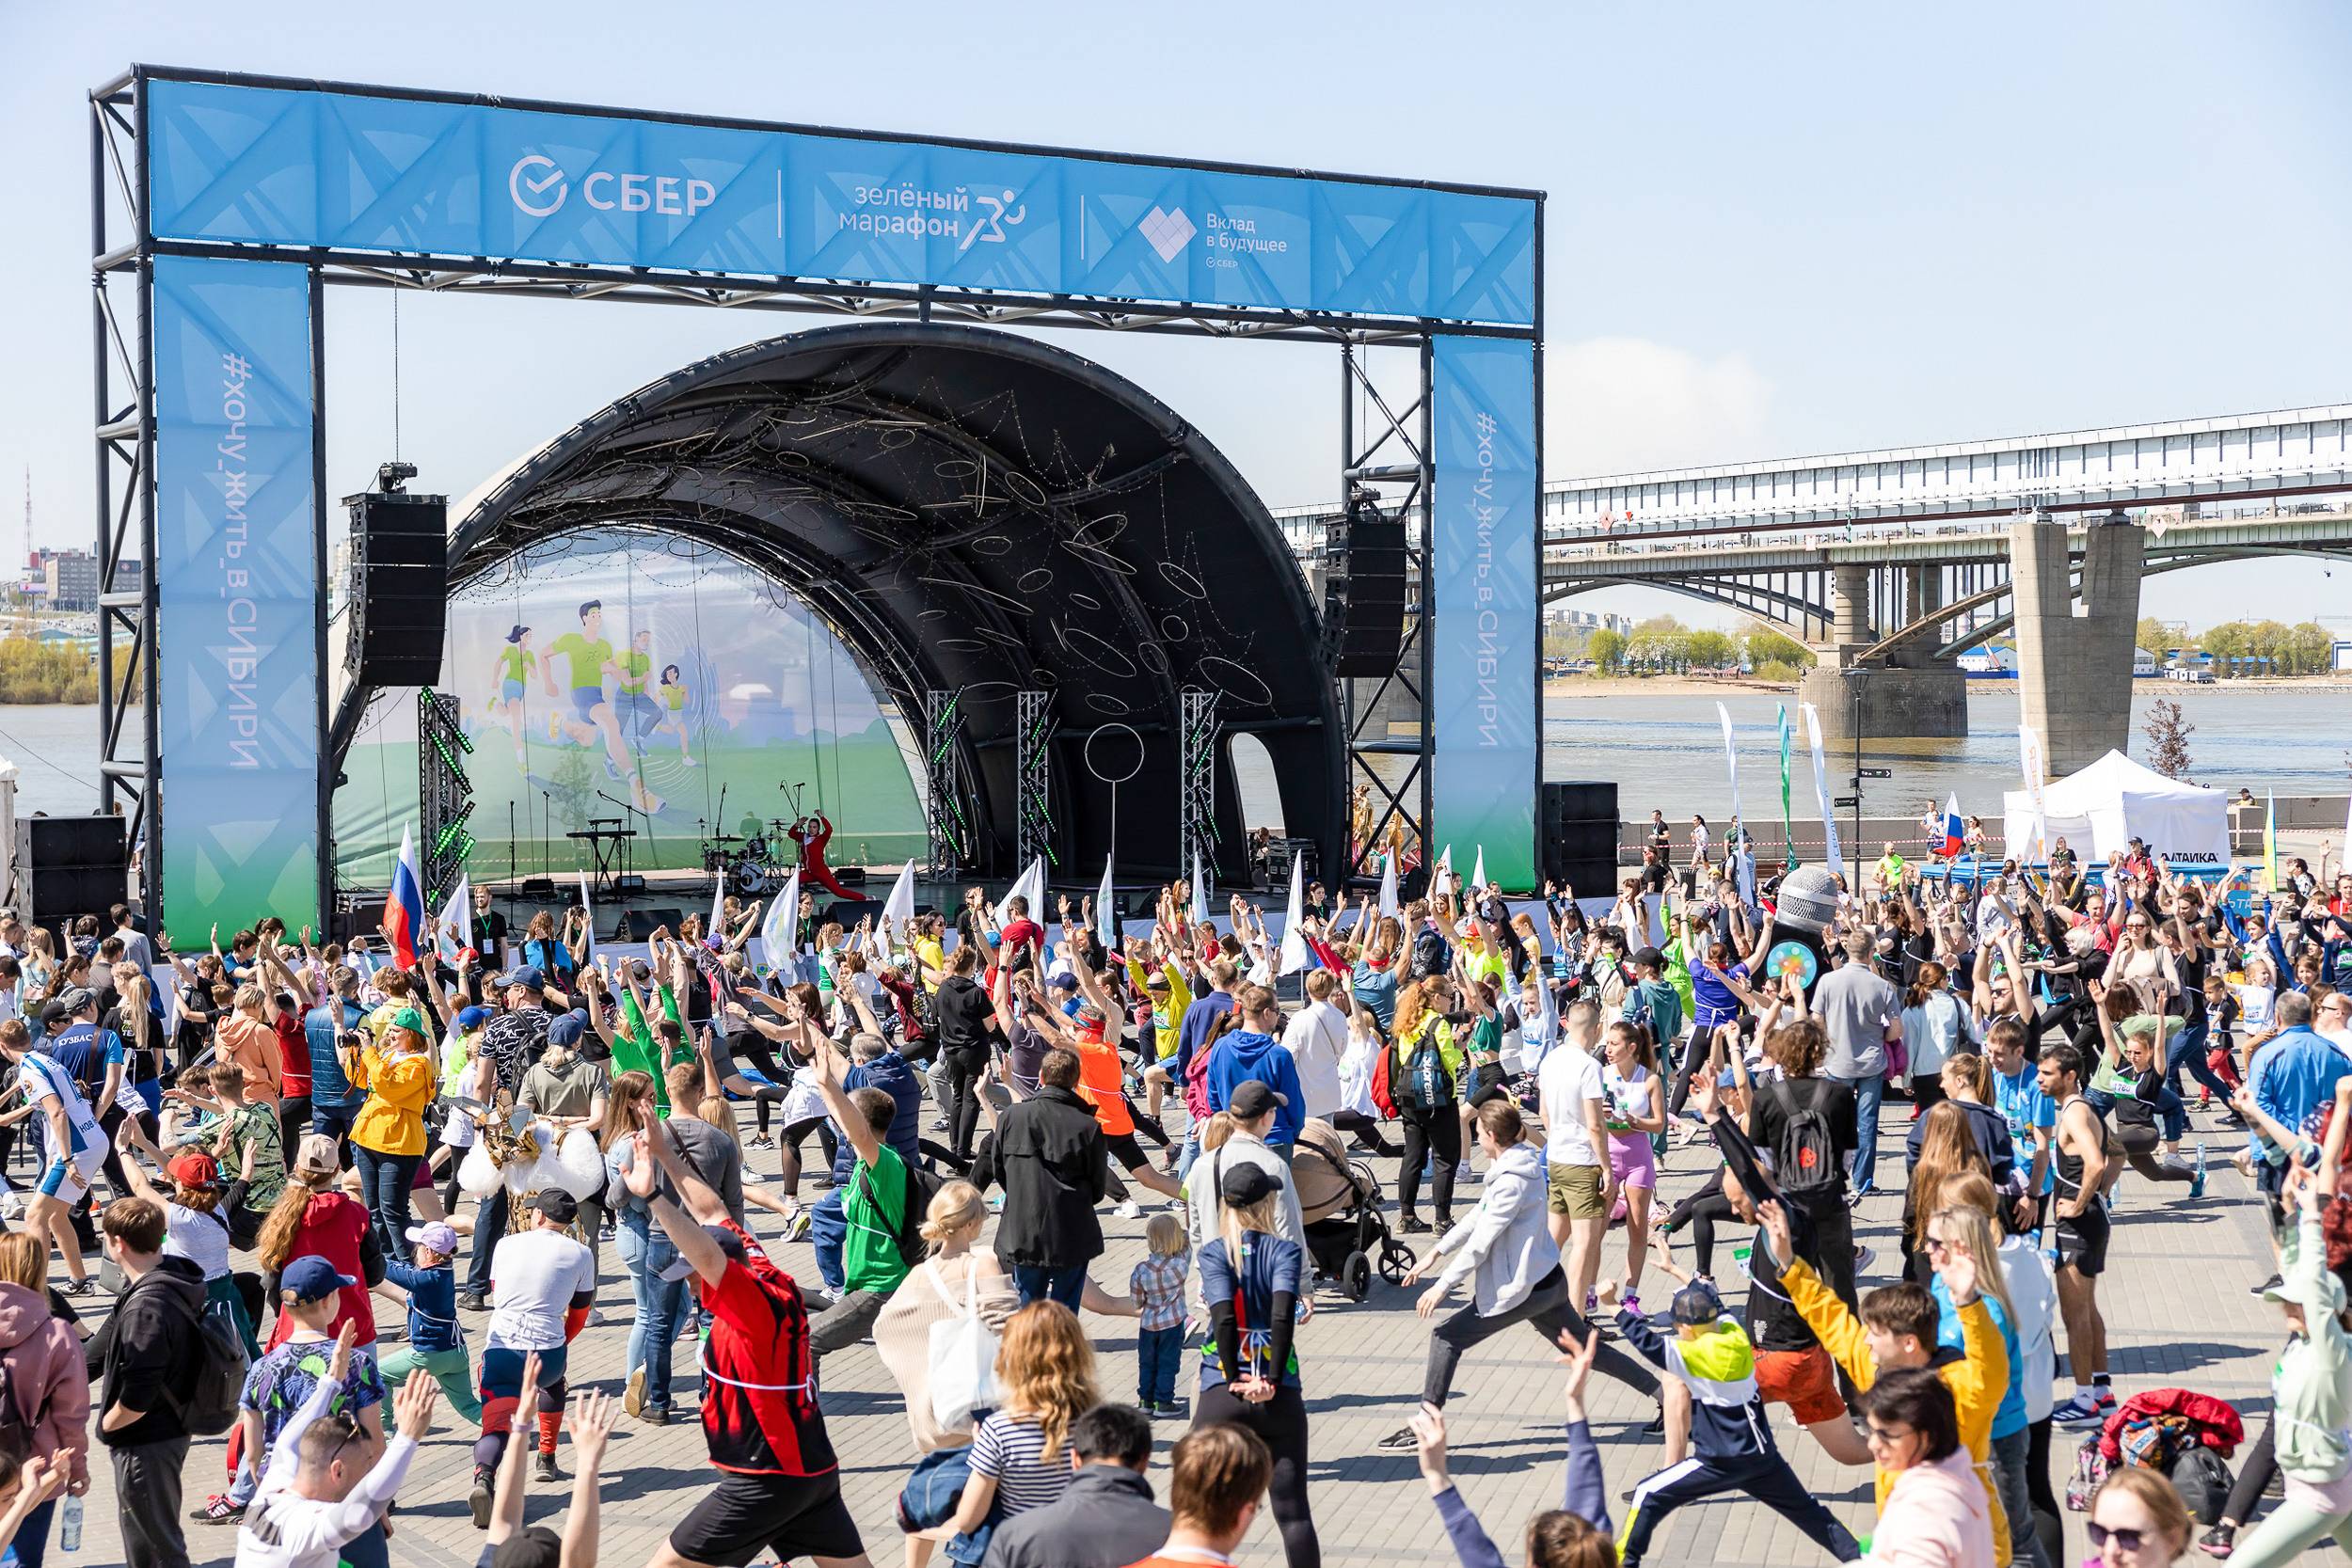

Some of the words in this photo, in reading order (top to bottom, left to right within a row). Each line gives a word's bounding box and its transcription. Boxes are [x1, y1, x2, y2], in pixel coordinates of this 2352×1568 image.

[583, 171, 716, 216] СБЕР
[854, 182, 968, 213] зелёный
[839, 209, 959, 241] марафон
[1206, 213, 1256, 234] Вклад
[1206, 235, 1216, 247] в
[1219, 231, 1288, 254] будущее
[1216, 259, 1239, 268] СБЕР
[57, 1034, 94, 1048] КУЗБАС
